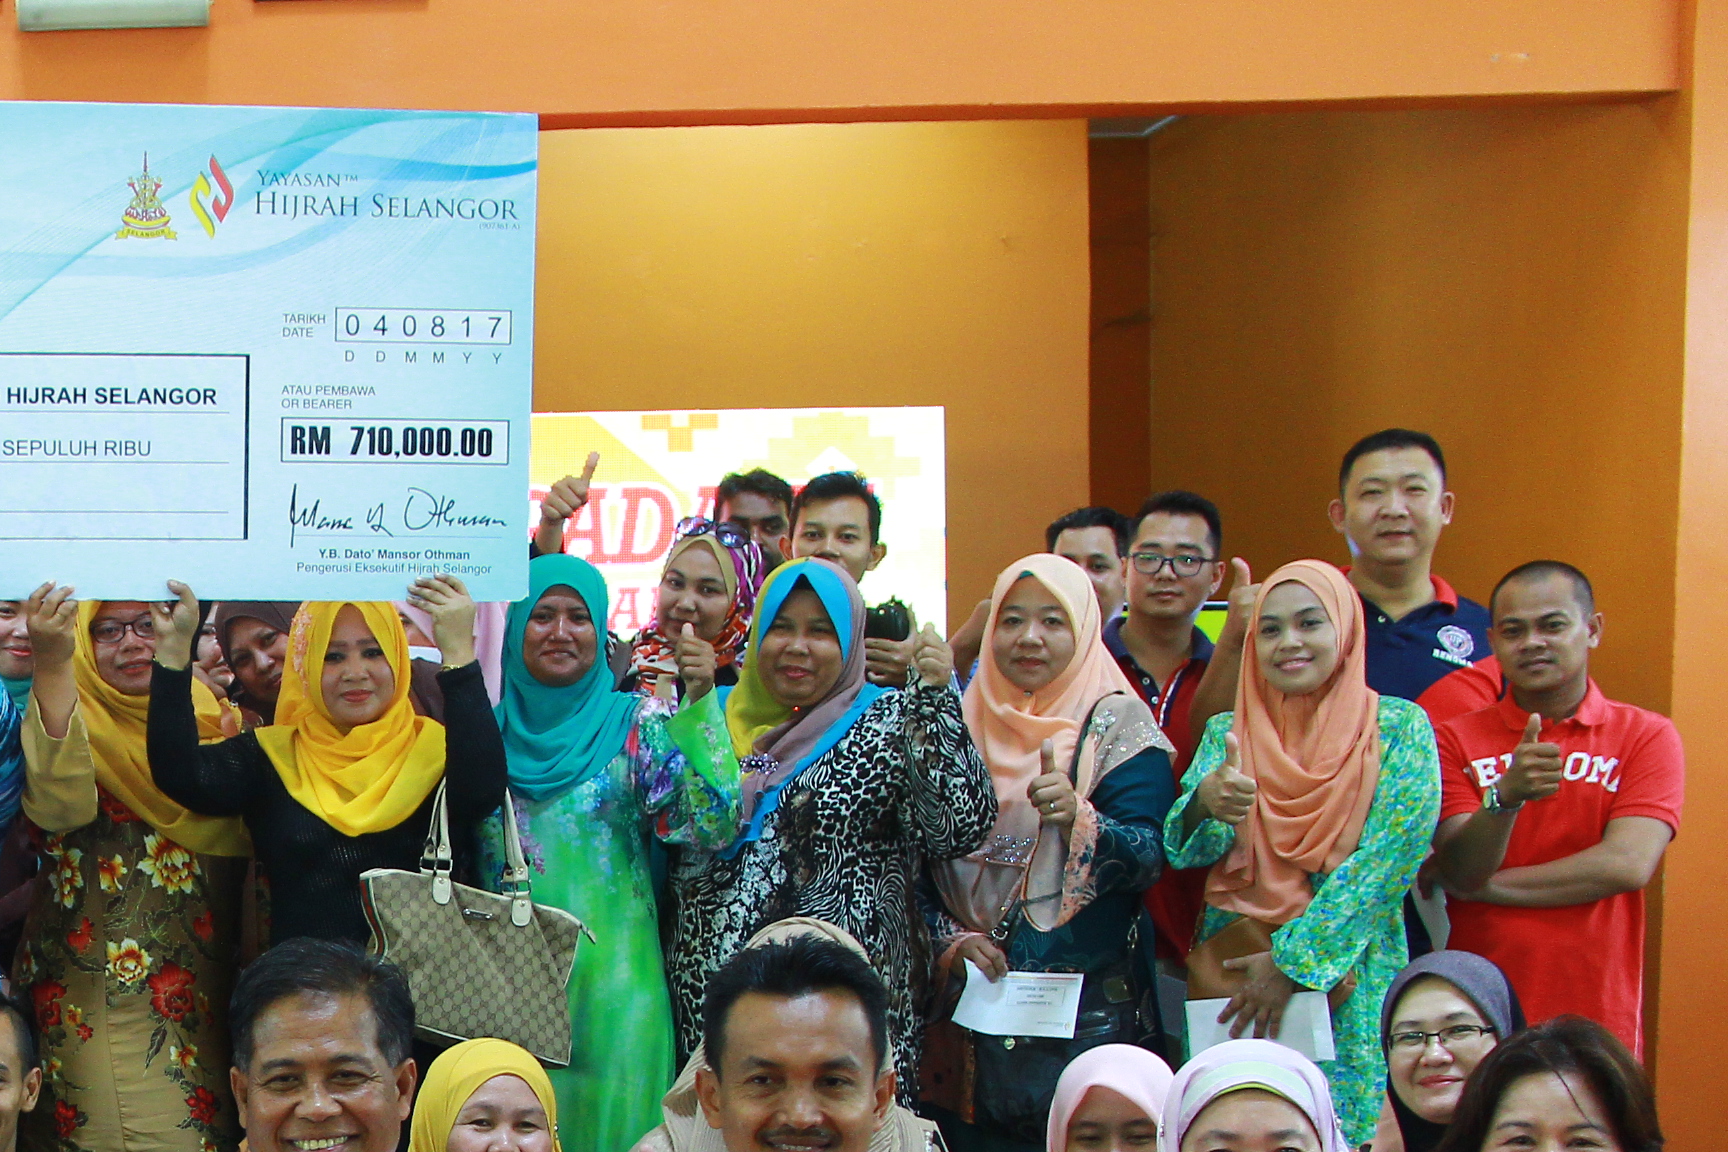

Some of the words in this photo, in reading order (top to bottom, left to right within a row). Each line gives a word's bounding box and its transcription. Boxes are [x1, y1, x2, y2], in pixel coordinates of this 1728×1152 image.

[256, 191, 357, 219] HIJRAH
[372, 193, 517, 219] SELANGOR
[283, 314, 325, 324] TARIKH
[283, 327, 313, 337] DATE
[8, 387, 86, 404] HIJRAH
[95, 388, 216, 404] SELANGOR
[282, 385, 311, 395] ATAU
[316, 385, 375, 395] PEMBAWA
[282, 399, 299, 408] OR
[303, 399, 352, 409] BEARER
[3, 440, 96, 456] SEPULUH
[105, 441, 150, 456] RIBU
[291, 426, 330, 454] RM
[350, 426, 493, 459] 710,000.00
[319, 549, 340, 558] Y.B.
[378, 549, 421, 559] Mansor
[425, 550, 469, 559] Othman
[297, 562, 351, 574] Pengerusi
[355, 562, 405, 573] Eksekutif
[407, 562, 440, 576] Hijrah
[443, 564, 492, 576] Selangor
